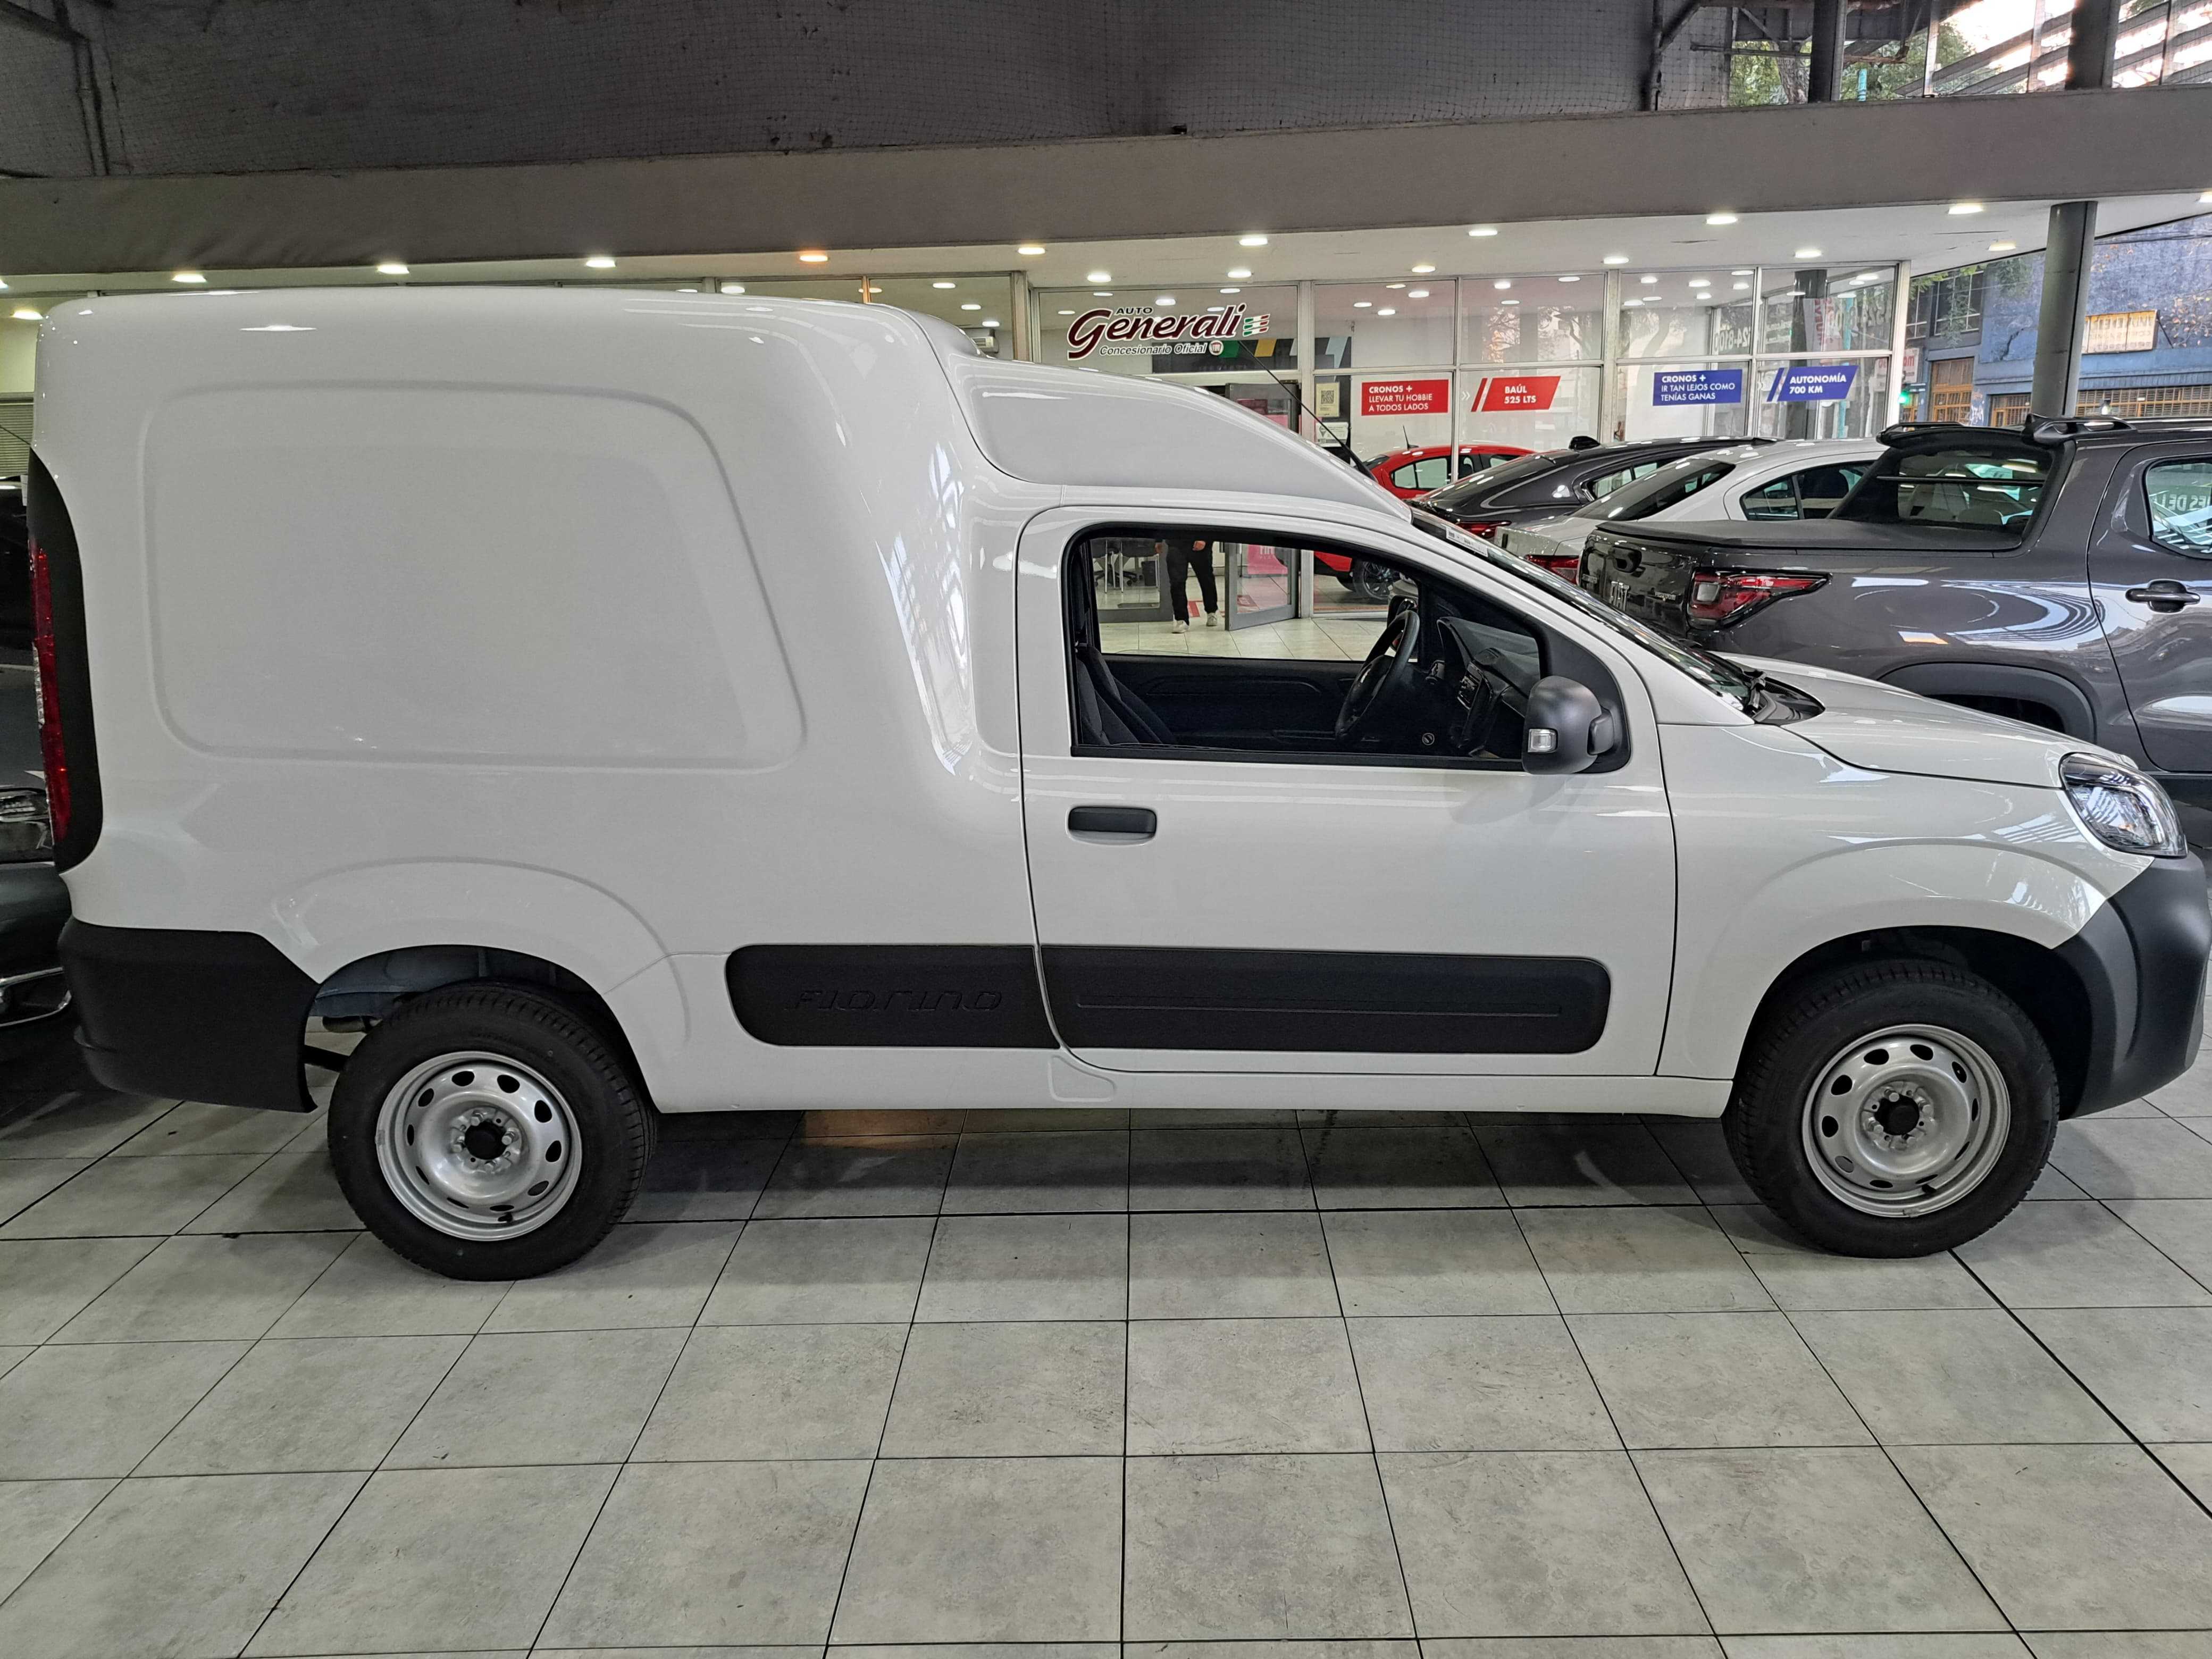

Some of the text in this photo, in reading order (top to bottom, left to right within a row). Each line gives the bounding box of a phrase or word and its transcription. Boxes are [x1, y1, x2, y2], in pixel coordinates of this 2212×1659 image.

[1067, 303, 1246, 360] Generali
[1100, 345, 1172, 355] Concesionario
[1174, 342, 1208, 355] Oficial
[1790, 373, 1846, 384] AUTONOMÍA
[1505, 384, 1527, 393] BAÚL
[1661, 392, 1687, 401] TENÍAS
